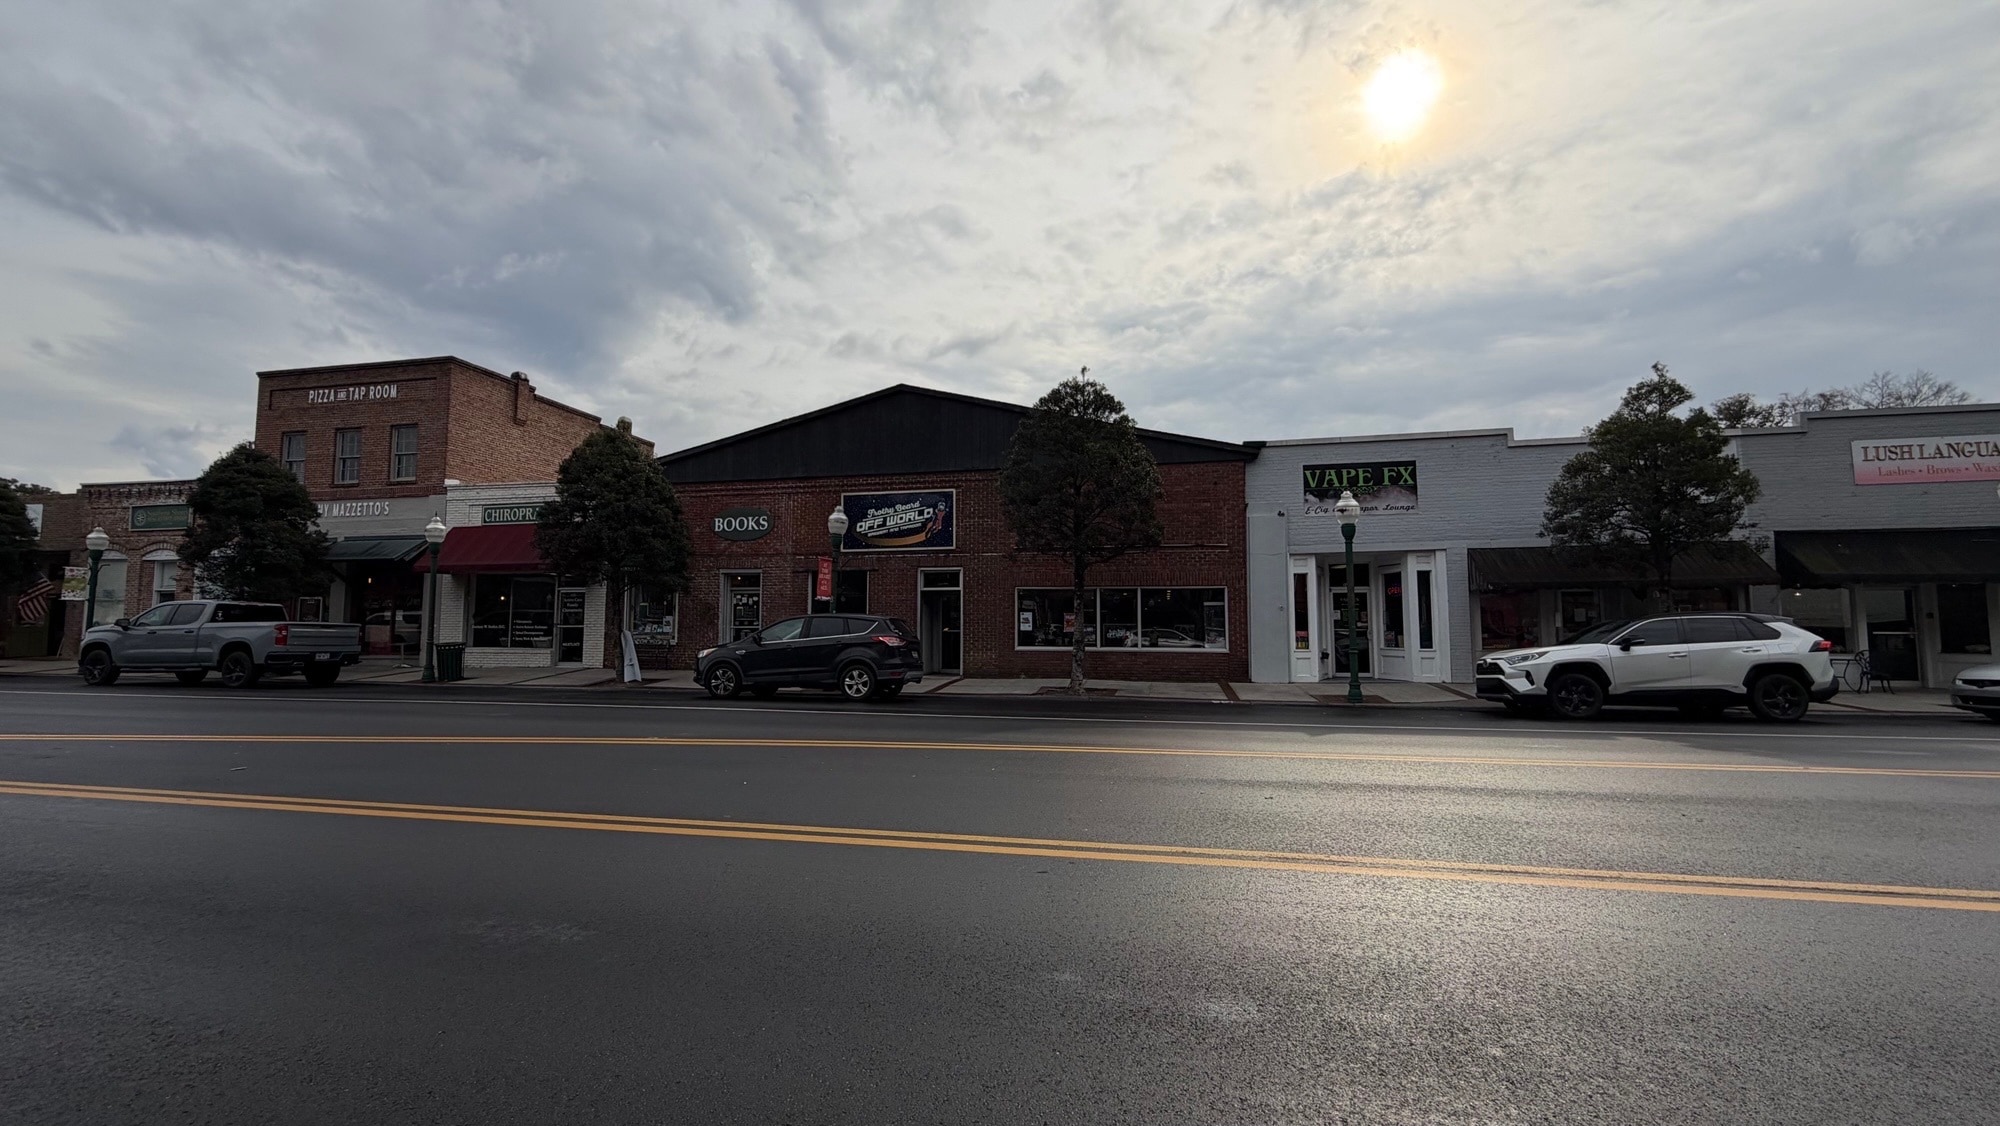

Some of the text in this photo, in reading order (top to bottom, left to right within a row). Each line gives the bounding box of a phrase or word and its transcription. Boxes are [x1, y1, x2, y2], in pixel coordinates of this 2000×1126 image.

[309, 389, 335, 403] PIZZA
[348, 387, 366, 401] TAP
[369, 384, 397, 399] ROOM
[1861, 444, 1915, 462] LUSH
[1304, 466, 1415, 488] VAPE FX
[1878, 466, 1916, 477] Lashes
[1926, 464, 1962, 475] Brows
[332, 501, 390, 517] MAZZETTO'S
[714, 515, 769, 532] BOOKS
[856, 508, 934, 533] OFF WORLD
